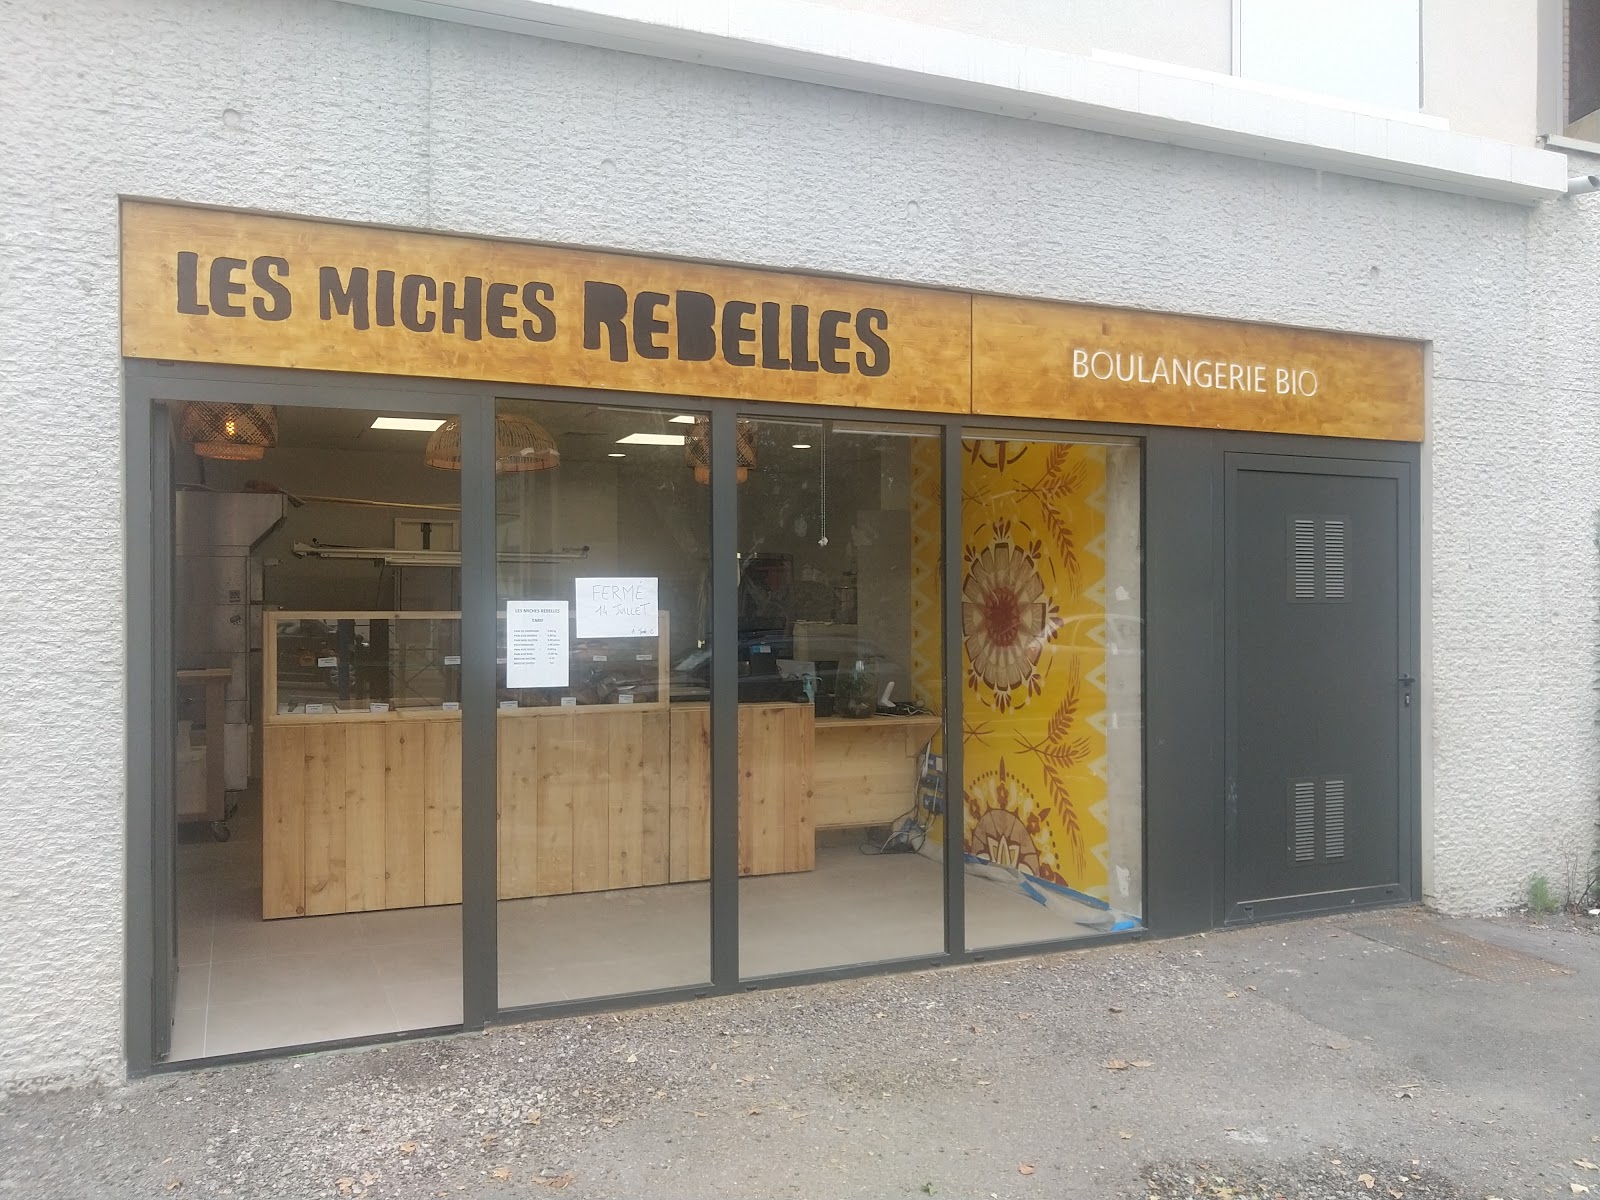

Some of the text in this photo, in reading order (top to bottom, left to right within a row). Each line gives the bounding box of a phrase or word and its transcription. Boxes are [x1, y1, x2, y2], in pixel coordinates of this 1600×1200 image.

[177, 251, 891, 377] LES MICHES REBELLES
[1072, 347, 1318, 397] BOULANGERIE BIO
[592, 580, 644, 602] FERMÉ
[594, 602, 650, 617] 14 JUILLET
